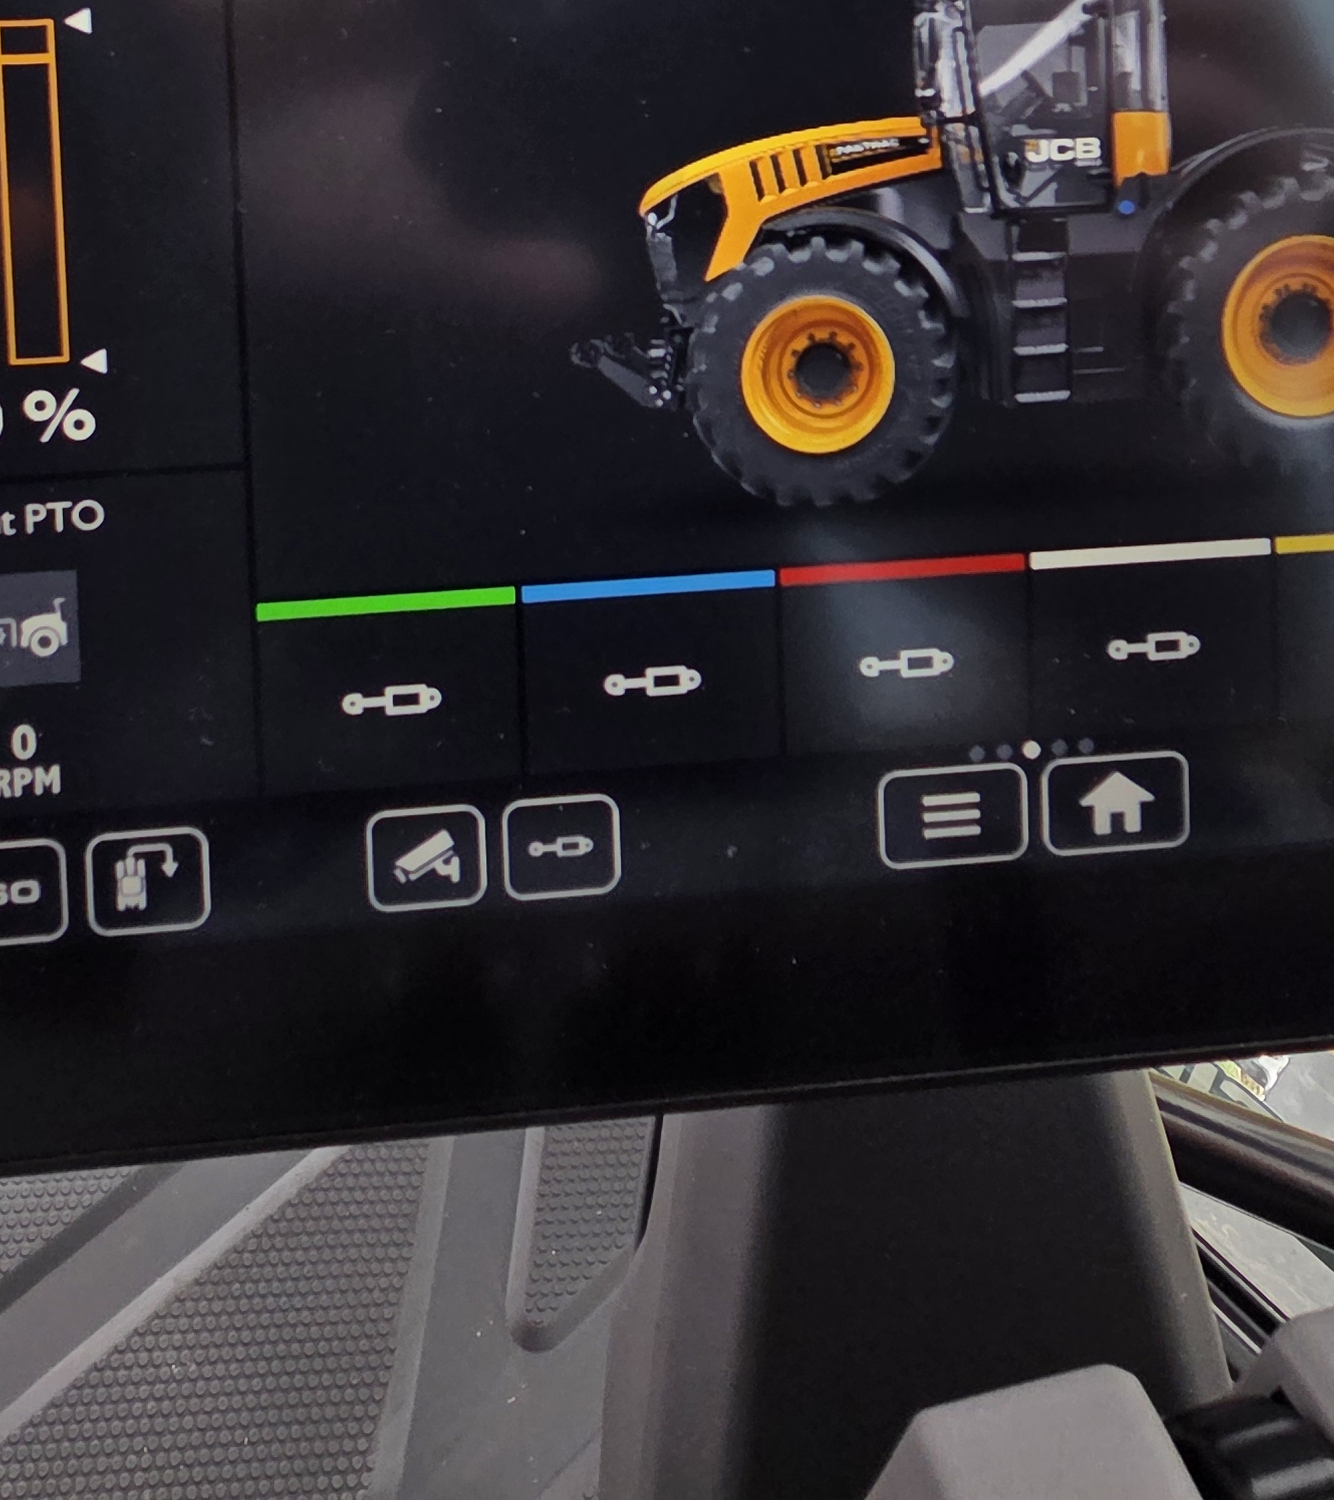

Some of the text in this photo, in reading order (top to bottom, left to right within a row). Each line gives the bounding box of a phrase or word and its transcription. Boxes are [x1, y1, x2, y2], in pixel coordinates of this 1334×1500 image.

[1024, 137, 1101, 163] JCB
[23, 387, 96, 443] %
[24, 499, 105, 535] PTO
[11, 723, 37, 761] 0
